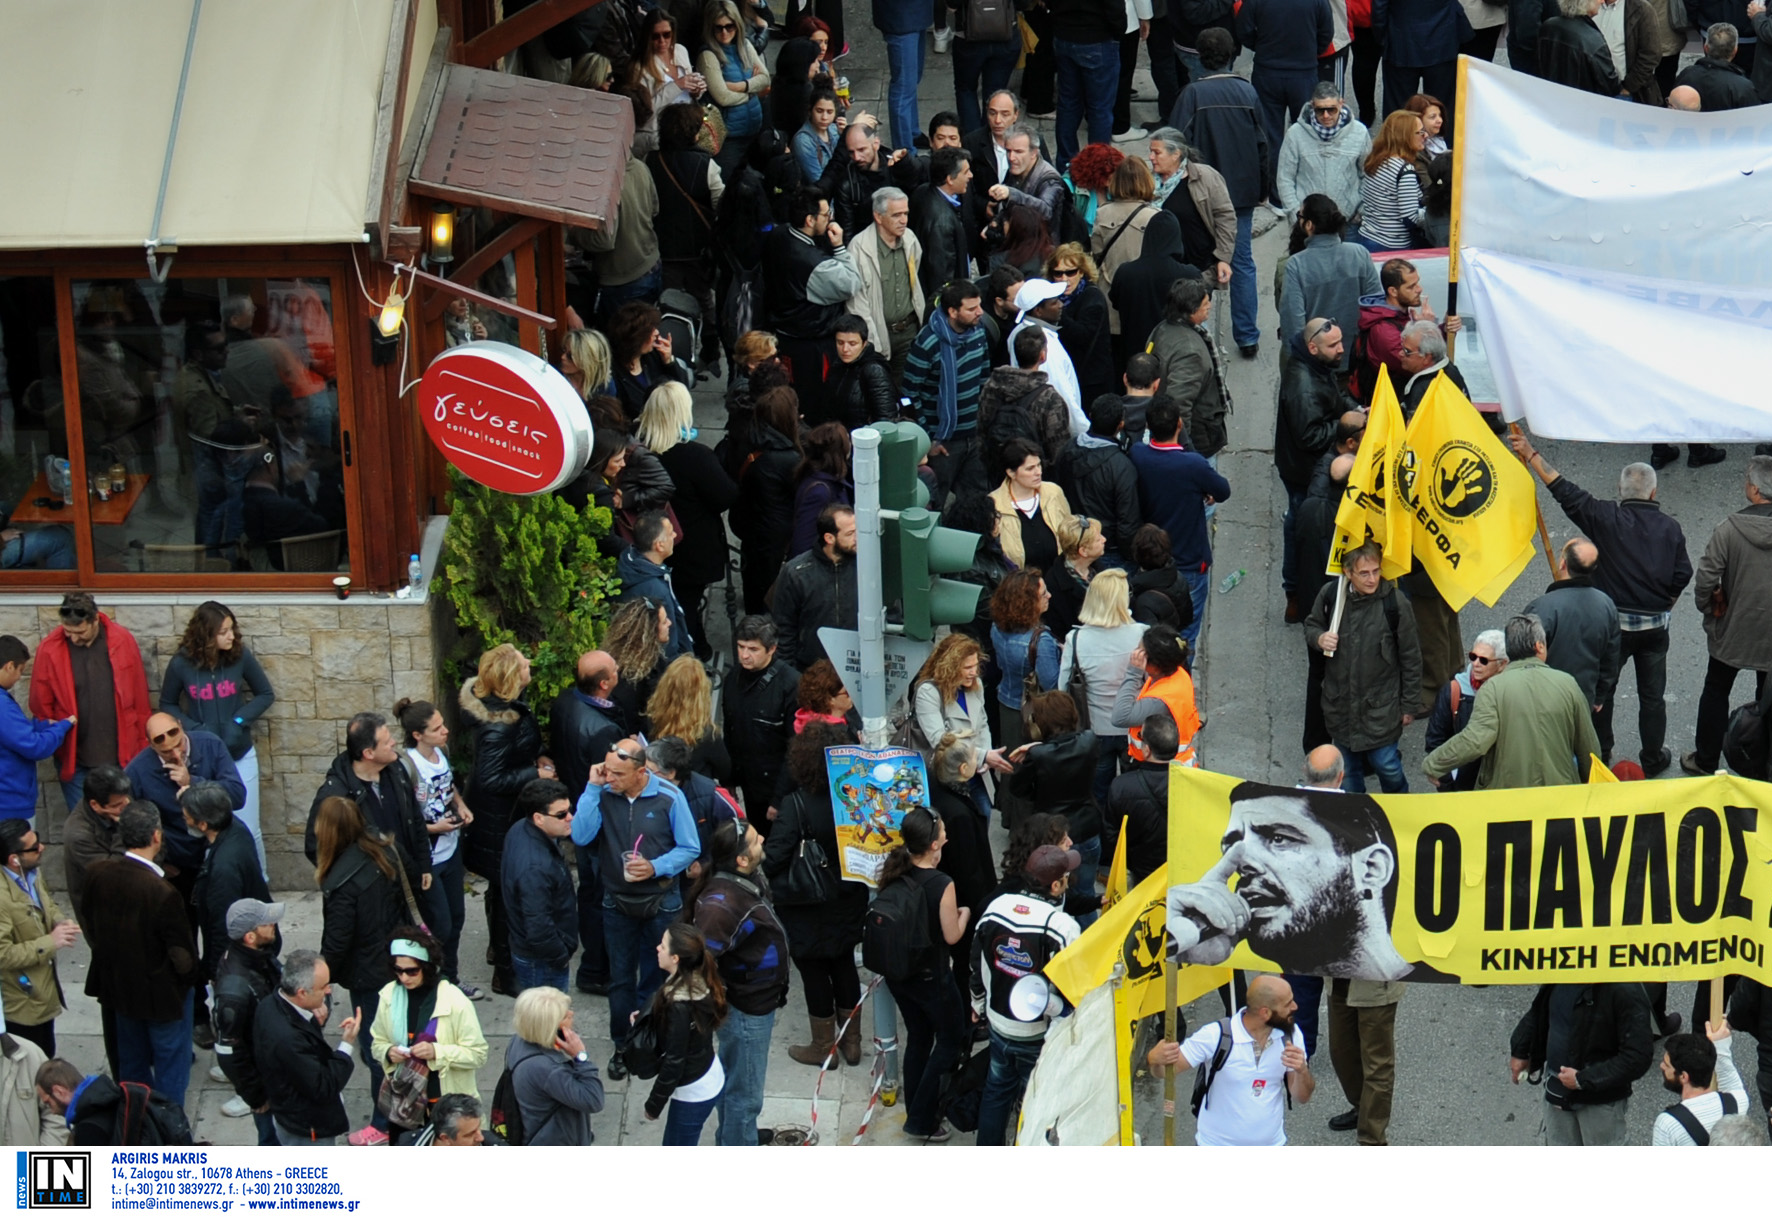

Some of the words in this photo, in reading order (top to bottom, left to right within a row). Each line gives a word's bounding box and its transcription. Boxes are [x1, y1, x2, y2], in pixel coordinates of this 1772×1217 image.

[434, 393, 548, 444] γεύσεις
[446, 422, 480, 439] coffee
[485, 434, 508, 449] food
[512, 445, 541, 460] snack
[1414, 822, 1462, 933] Ο
[1484, 805, 1758, 931] ΠΑΥΛΟΣ
[1481, 944, 1598, 971] ΚΙΝΗΣΗ
[1608, 934, 1764, 968] ΕΝΩΜΕΝΟΙ
